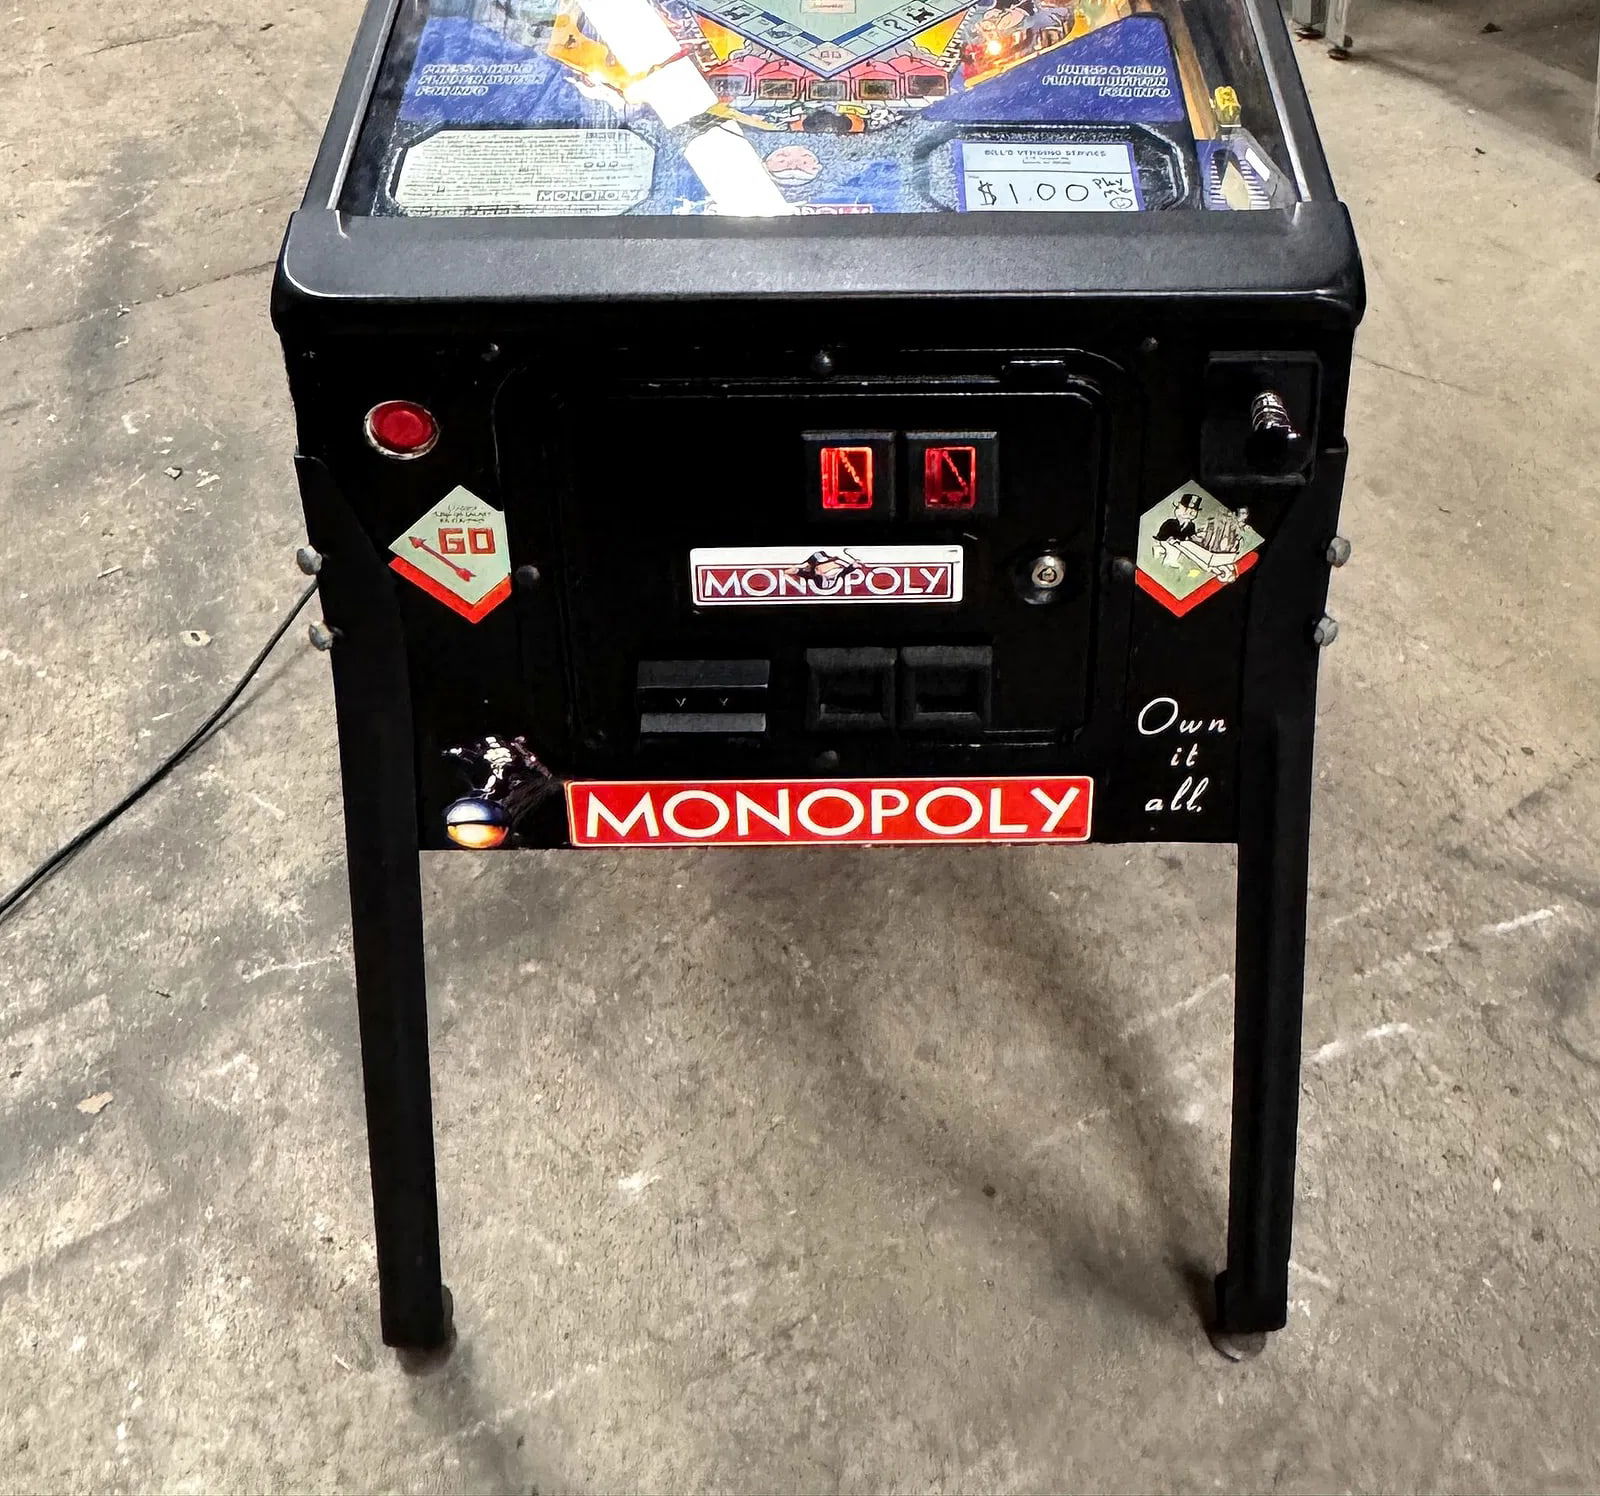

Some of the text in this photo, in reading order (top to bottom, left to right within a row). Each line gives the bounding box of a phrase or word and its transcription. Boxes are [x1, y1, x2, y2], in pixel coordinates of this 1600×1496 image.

[438, 527, 496, 555] GO
[704, 567, 946, 597] MONOPOLY
[1137, 697, 1227, 735] Own
[1170, 743, 1200, 768] it
[586, 786, 1081, 839] MONOPOLY
